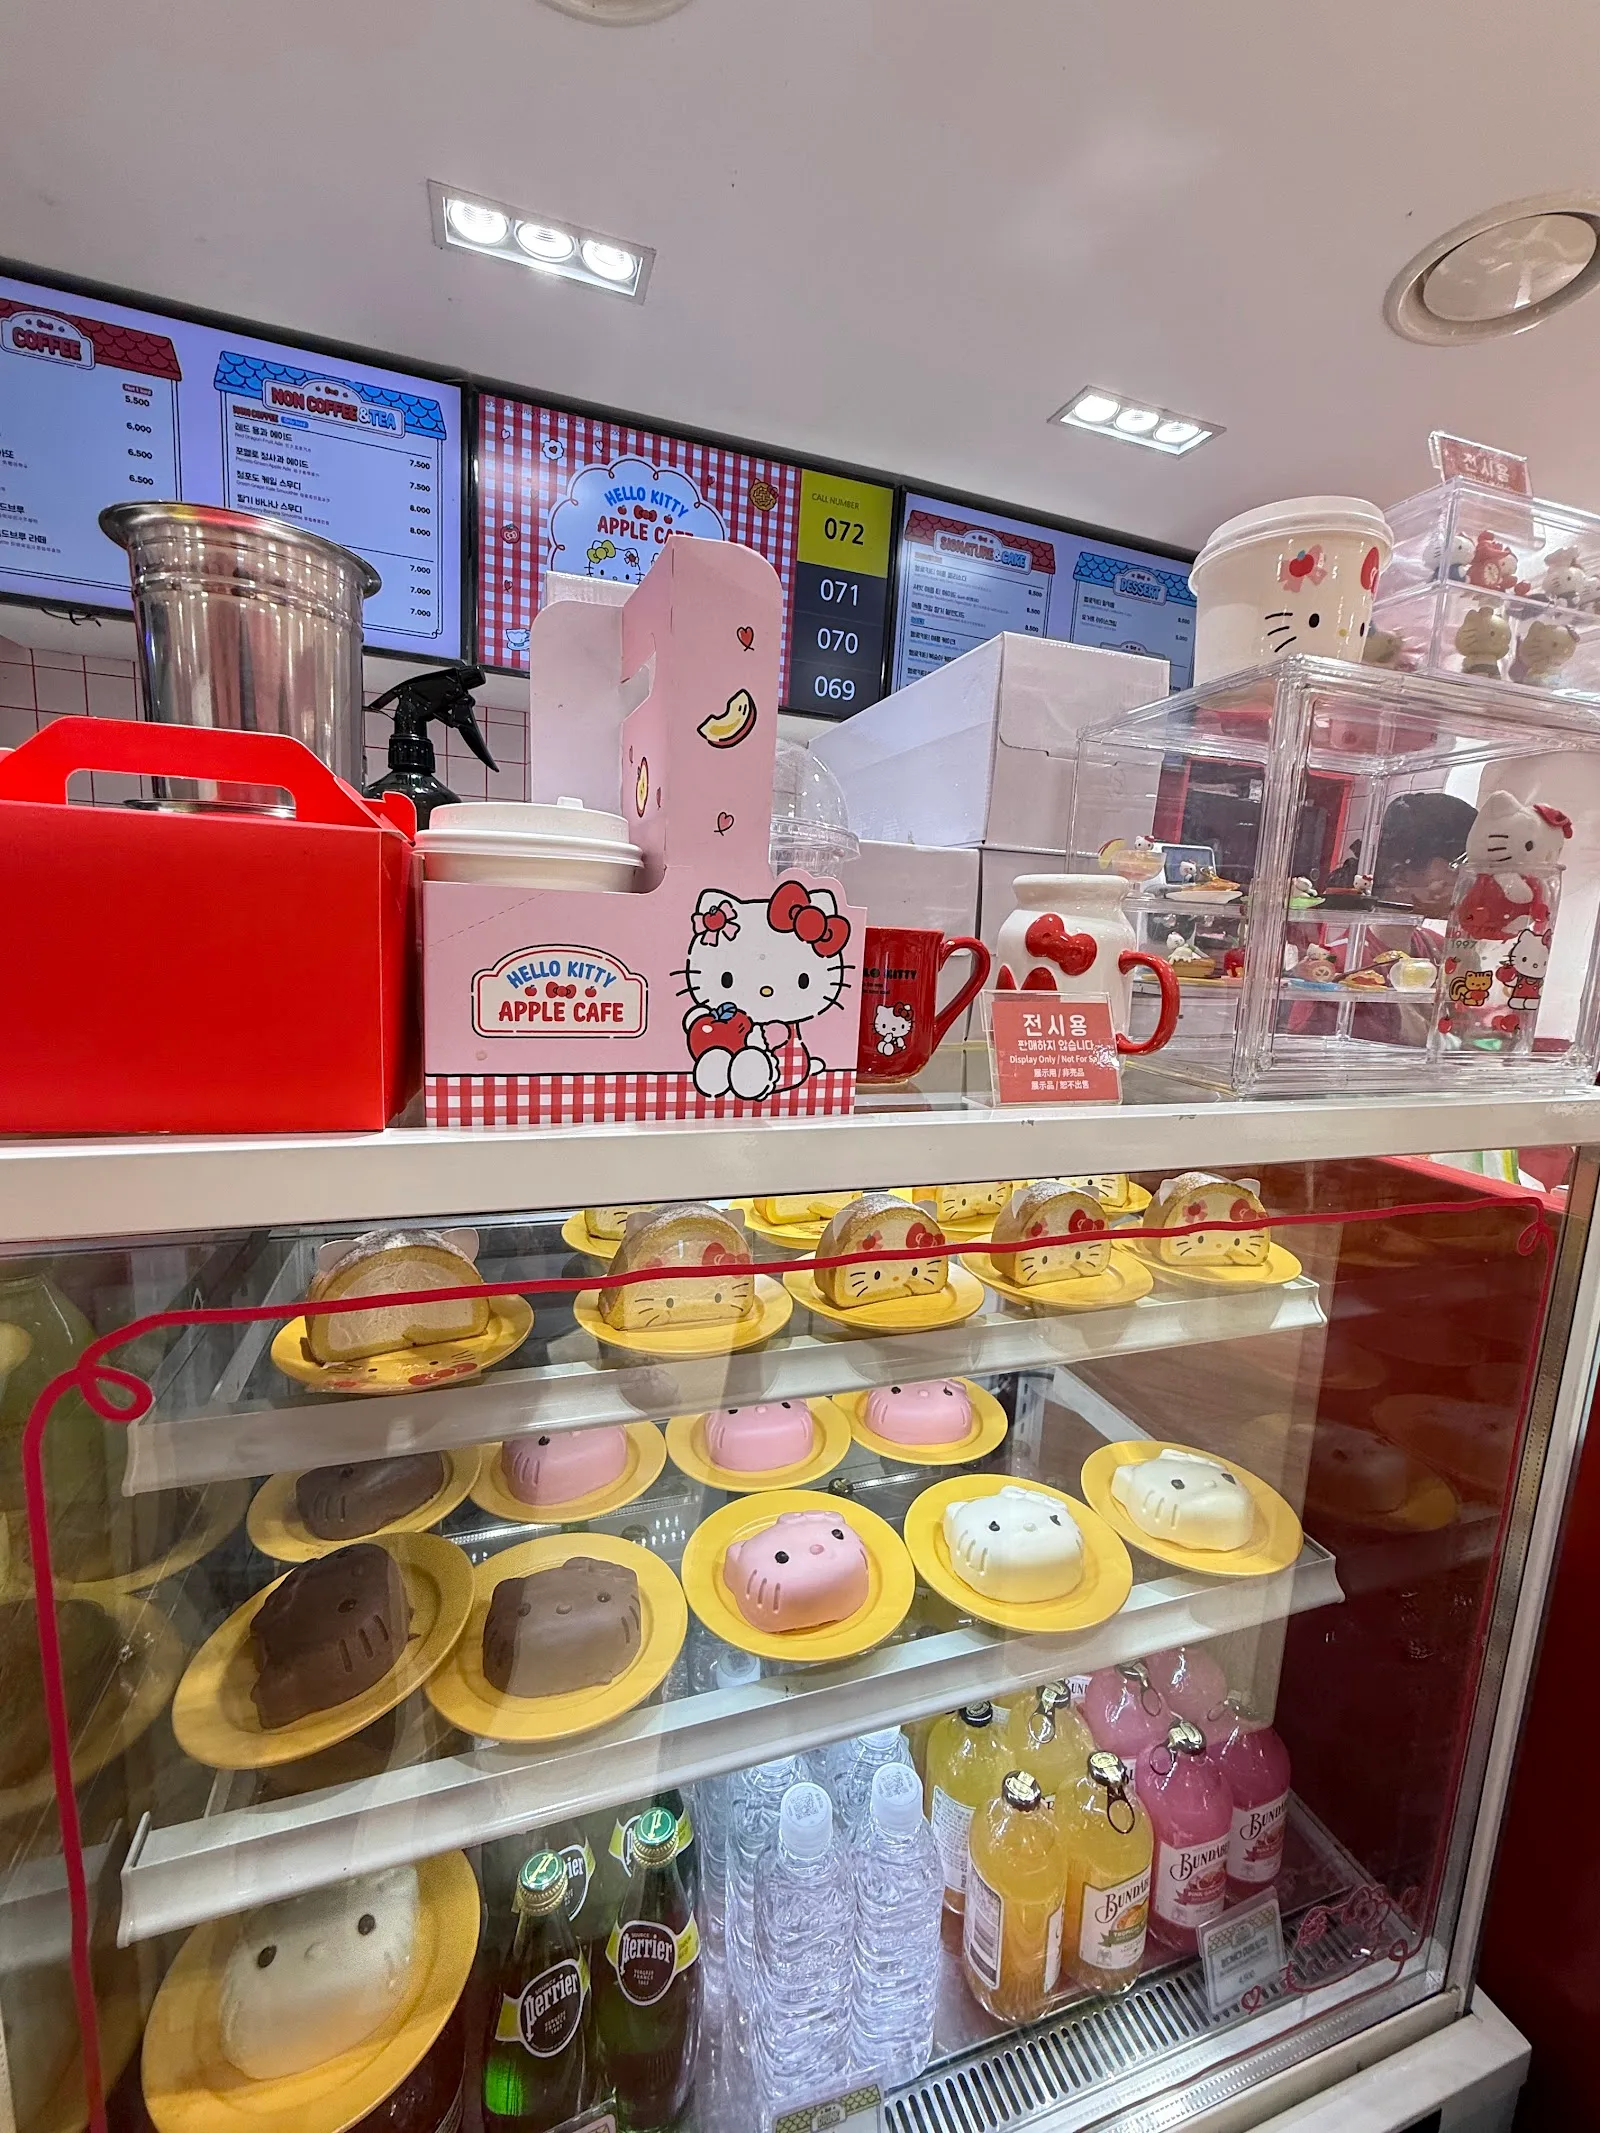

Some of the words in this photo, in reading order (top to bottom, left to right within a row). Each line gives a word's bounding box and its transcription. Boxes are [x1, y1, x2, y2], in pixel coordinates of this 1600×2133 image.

[12, 326, 82, 362] COFFEE
[271, 387, 305, 411] NON
[306, 396, 358, 422] COFFEE
[235, 422, 250, 433] 레드
[253, 426, 268, 437] 용과
[270, 430, 293, 442] 에이드
[287, 457, 309, 469] 에이드
[1463, 453, 1509, 483] 전시용
[280, 479, 301, 491] 스무디
[0, 503, 25, 514] 드브루
[237, 494, 253, 504] 딸기
[256, 497, 279, 510] 바나나
[281, 502, 302, 513] 스무디
[604, 486, 646, 507] HELLO
[651, 490, 689, 518] KITTY
[812, 493, 829, 504] CALL
[830, 497, 860, 510] NUMBER
[0, 529, 27, 541] 드브루
[29, 534, 47, 545] 라떼
[598, 516, 648, 541] APPLE
[655, 527, 693, 544] CA
[825, 518, 864, 546] 072
[821, 579, 859, 606] 071
[1120, 580, 1161, 601] DESSERT
[817, 628, 859, 655] 070
[815, 676, 856, 701] 069
[1452, 941, 1478, 950] 1997
[506, 961, 561, 989] HELLO
[568, 961, 617, 988] KITTY
[499, 1001, 565, 1022] APPLE
[573, 1003, 624, 1022] CAFE
[1023, 1014, 1087, 1037] 전시용
[1018, 1040, 1056, 1052] 판매하지
[1010, 1056, 1038, 1065] Display
[1039, 1056, 1056, 1065] Only
